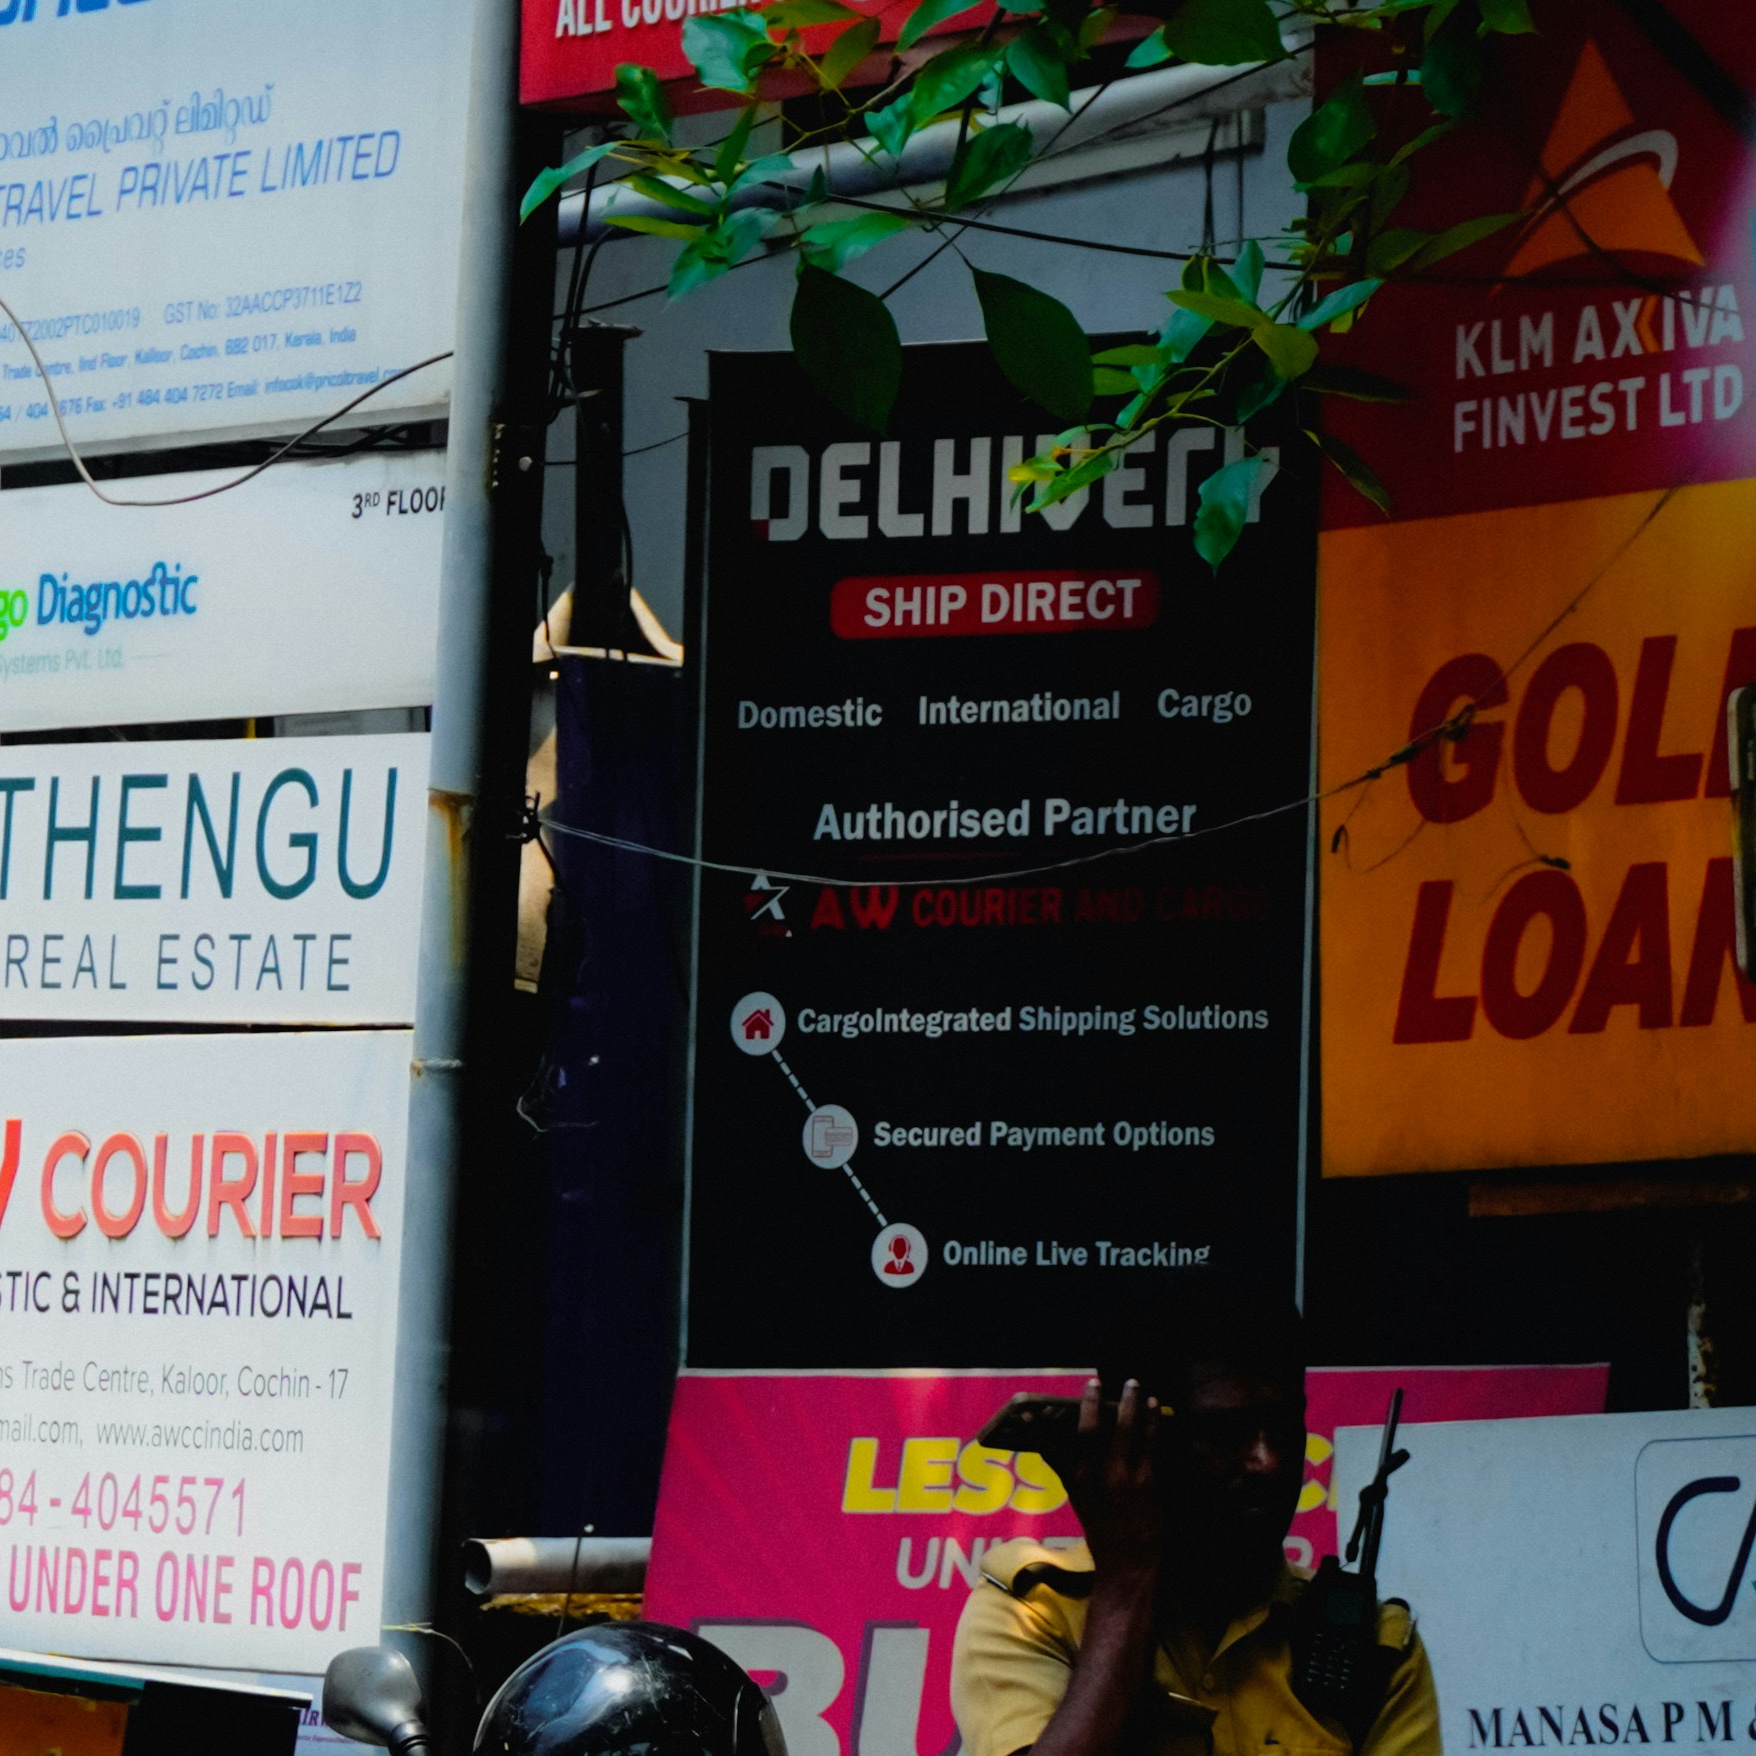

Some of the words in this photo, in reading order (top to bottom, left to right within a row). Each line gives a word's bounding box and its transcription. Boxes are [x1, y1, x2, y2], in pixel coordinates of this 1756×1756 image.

[116, 150, 252, 213] PRIVATE
[260, 130, 401, 193] LIMITED
[164, 301, 193, 325] GST
[1455, 310, 1555, 380] KLM
[193, 382, 224, 402] 7272
[1453, 376, 1645, 454] FINVEST
[1659, 363, 1745, 429] LTD
[35, 561, 200, 636] Diagnostic
[864, 585, 968, 628] SHIP
[980, 578, 1143, 624] DIRECT
[737, 697, 883, 730] Domestic
[919, 690, 1120, 726] International
[1156, 687, 1252, 724] Cargo
[813, 799, 1030, 841] Authorised
[1044, 797, 1197, 836] Partner
[809, 886, 899, 931] AW
[912, 887, 1062, 929] COURIER
[4, 933, 128, 991] REAL
[156, 932, 354, 992] ESTATE
[797, 1007, 1012, 1039] CargoIntegrated
[1018, 1005, 1136, 1038] Shipping
[1143, 1003, 1269, 1031] Solutions
[873, 1121, 982, 1148] Secured
[989, 1121, 1106, 1152] Payment
[1113, 1120, 1215, 1152] Options
[41, 1130, 382, 1241] COURIER
[944, 1241, 1028, 1268] Online
[1036, 1241, 1088, 1268] Live
[1095, 1240, 1211, 1268] Tracking
[60, 1272, 81, 1313] &
[91, 1270, 353, 1320] INTERNATIONAL
[21, 1360, 75, 1393] Trade
[82, 1361, 155, 1399] Centre,
[160, 1363, 229, 1400] Kaloor,
[237, 1364, 311, 1399] Cochin
[327, 1367, 350, 1400] 17
[96, 1417, 305, 1454] www.awccindia.com
[70, 1470, 246, 1538] 4045571
[8, 1543, 138, 1619] UNDER
[155, 1550, 236, 1625] ONE
[249, 1556, 363, 1633] ROOF
[1468, 1703, 1651, 1749] MANASA
[1661, 1701, 1686, 1745] P
[1696, 1700, 1735, 1743] M
